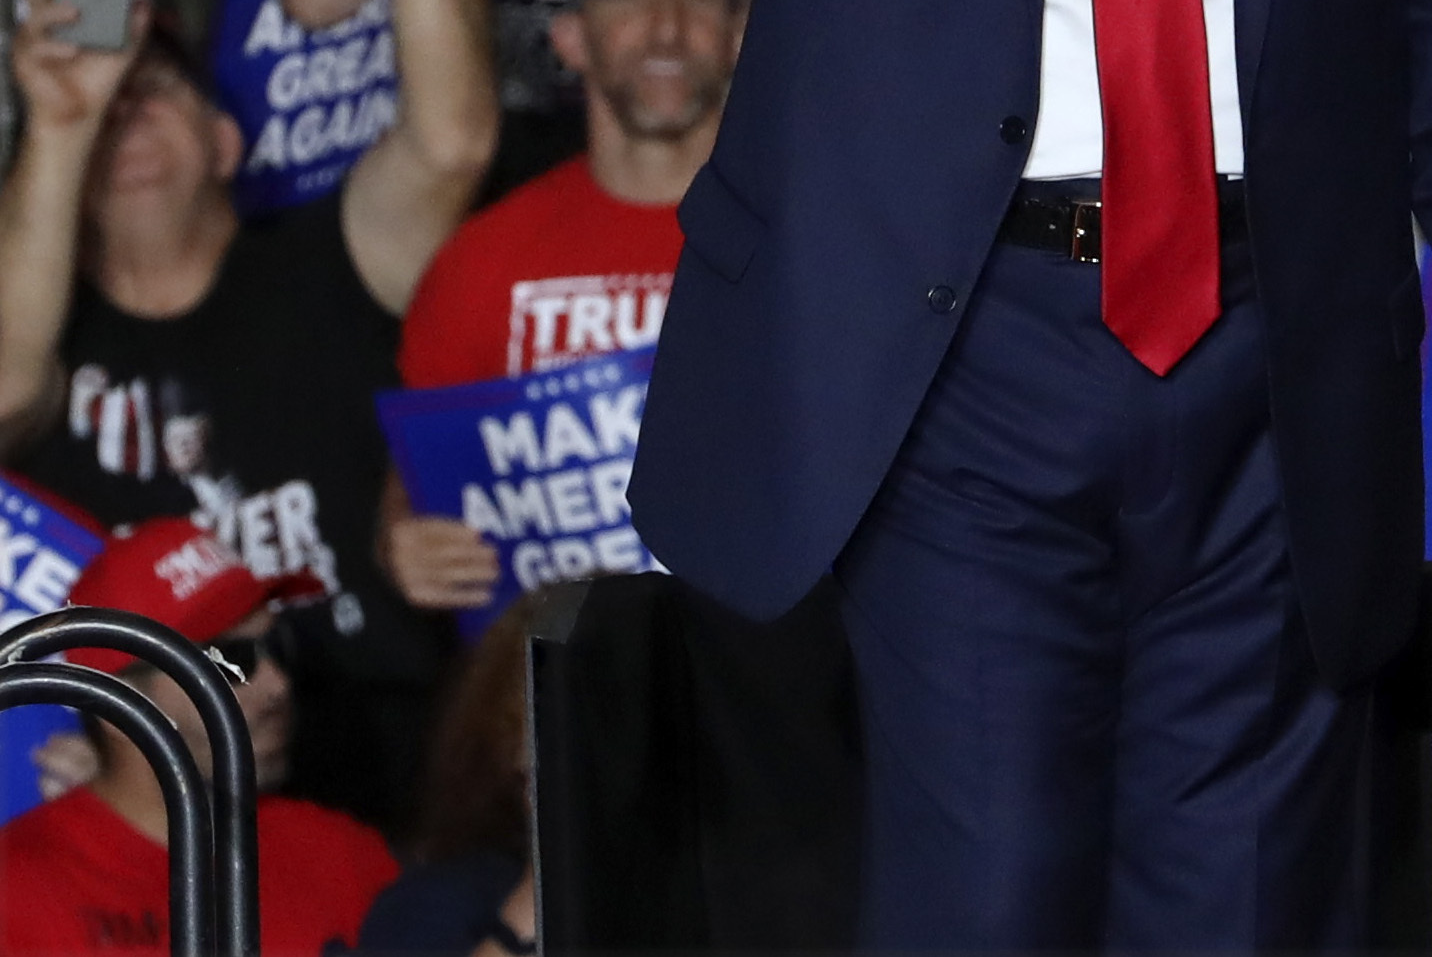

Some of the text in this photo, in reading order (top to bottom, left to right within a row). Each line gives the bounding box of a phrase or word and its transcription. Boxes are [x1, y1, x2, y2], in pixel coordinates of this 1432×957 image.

[530, 290, 668, 355] TRU
[478, 383, 650, 479] MAK
[461, 458, 637, 541] AMER
